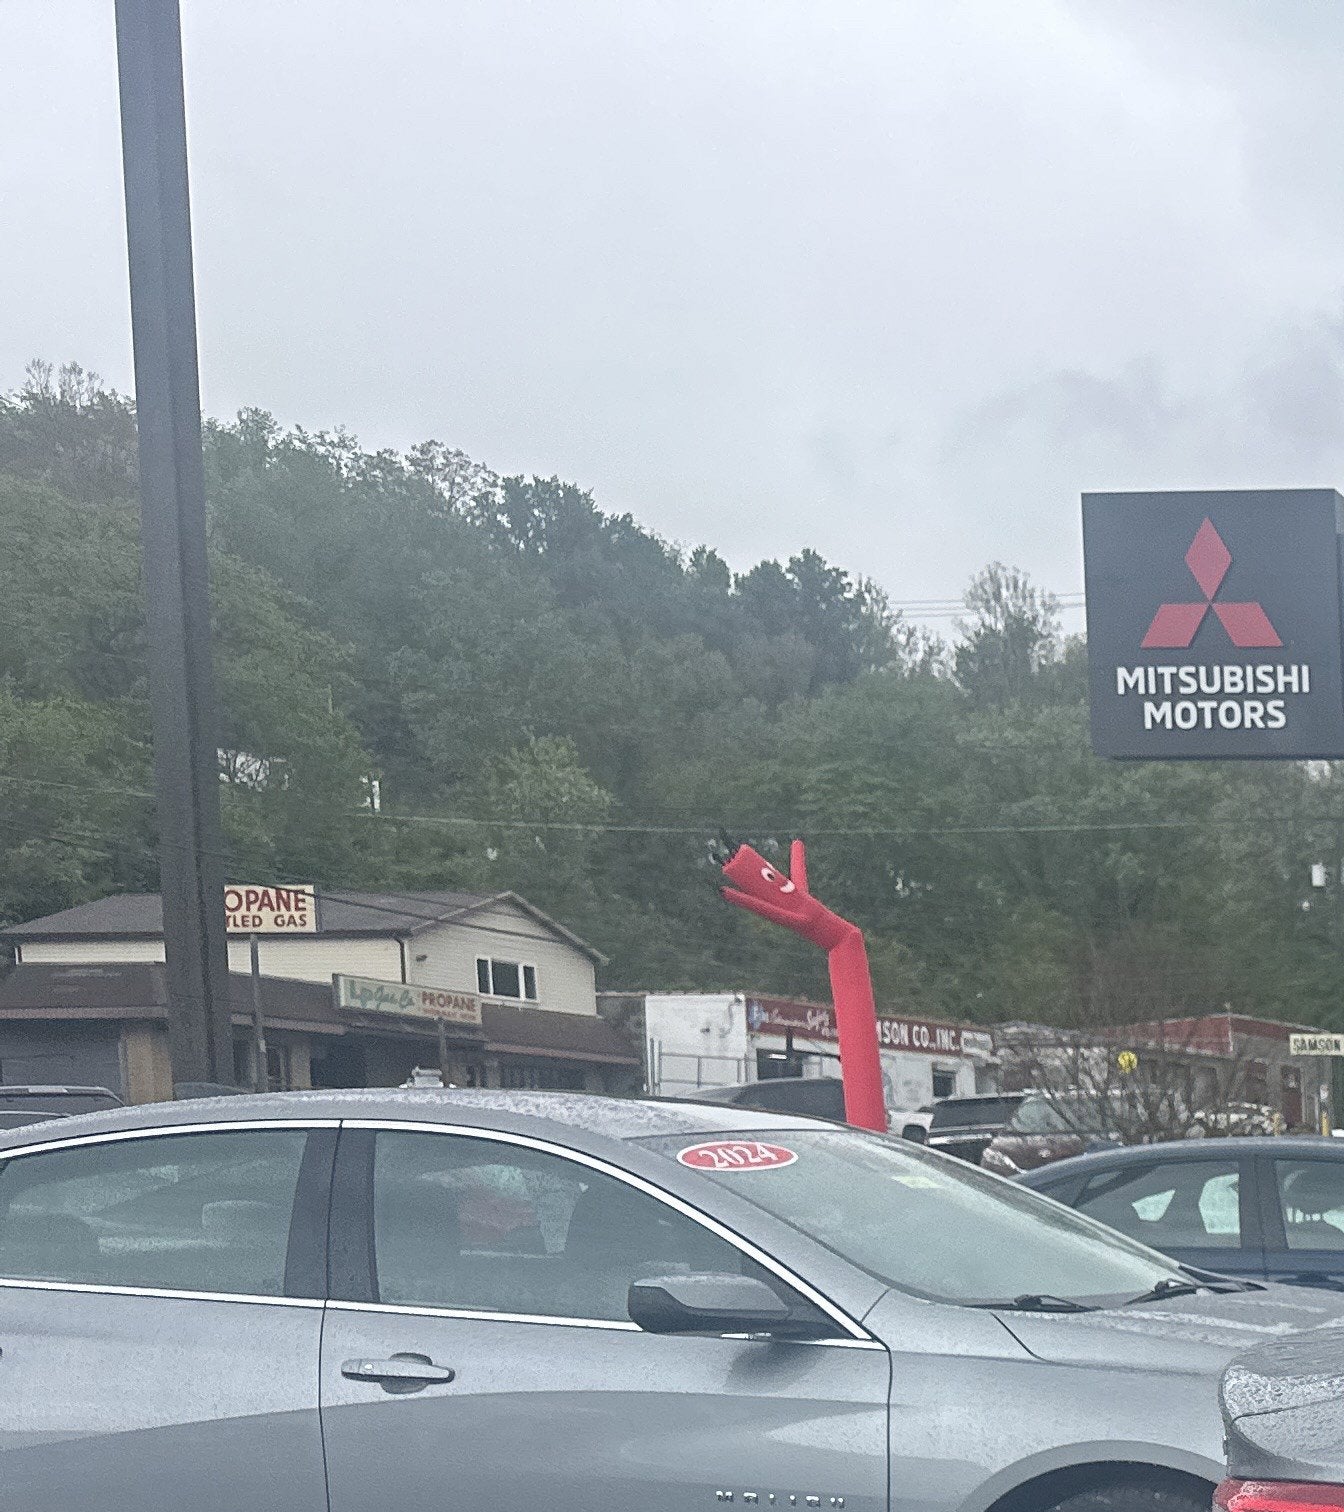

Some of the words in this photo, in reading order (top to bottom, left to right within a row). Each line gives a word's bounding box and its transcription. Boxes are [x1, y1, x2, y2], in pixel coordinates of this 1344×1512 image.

[1116, 664, 1310, 696] MITSUBISHI
[1144, 699, 1287, 730] MOTORS
[273, 913, 307, 928] GAS
[421, 990, 476, 1012] PROPANE
[1293, 1037, 1341, 1052] SAMSON
[698, 1143, 779, 1169] 2024
